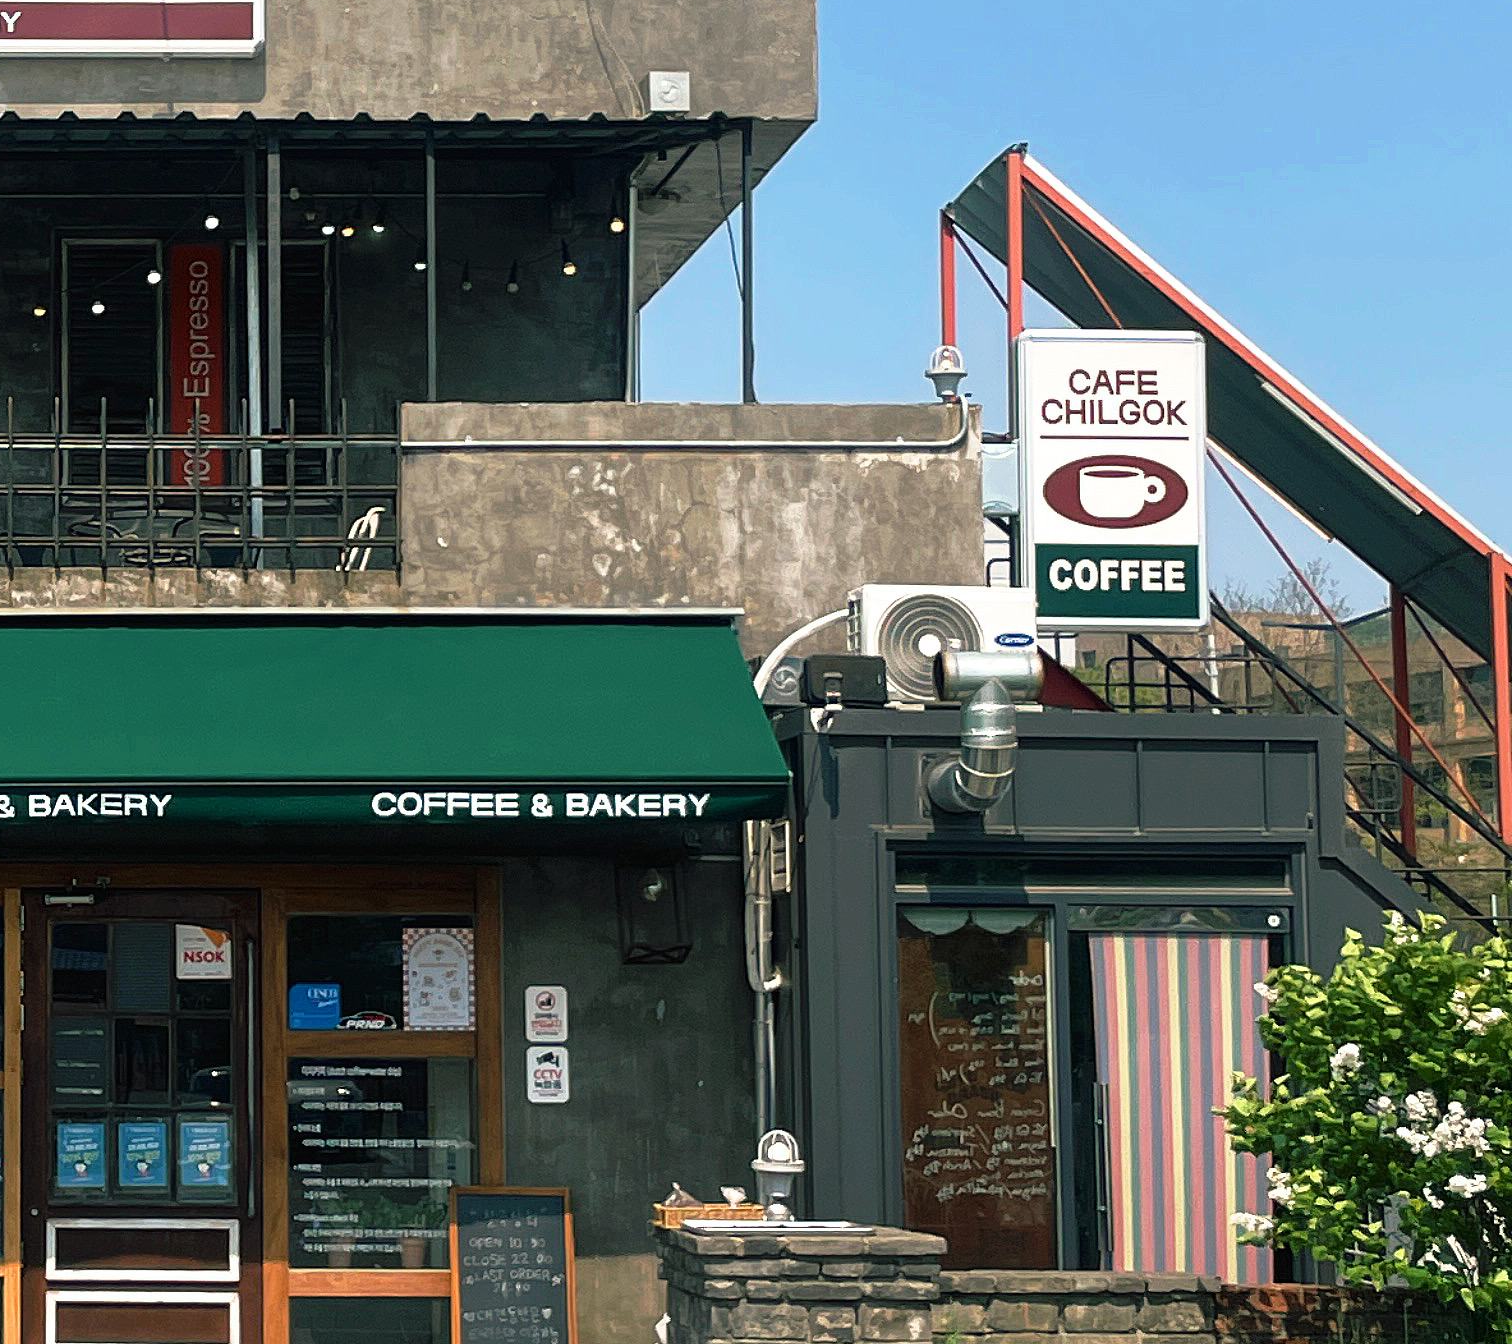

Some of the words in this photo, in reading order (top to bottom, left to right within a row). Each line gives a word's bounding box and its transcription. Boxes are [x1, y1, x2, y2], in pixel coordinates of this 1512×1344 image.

[183, 260, 216, 398] Espresso
[1068, 368, 1159, 395] CAFE
[1040, 398, 1188, 426] CHILGOK
[1048, 558, 1186, 592] COFFEE
[27, 792, 173, 817] BAKERY
[371, 791, 520, 817] COFFEE
[530, 793, 554, 818] &
[565, 792, 711, 817] BAKERY
[183, 951, 225, 963] NSOK
[533, 1069, 563, 1080] CCTV
[468, 1236, 503, 1250] OPEN
[463, 1253, 506, 1267] CLOSE
[475, 1268, 504, 1282] LAST
[509, 1268, 550, 1281] ORDER
